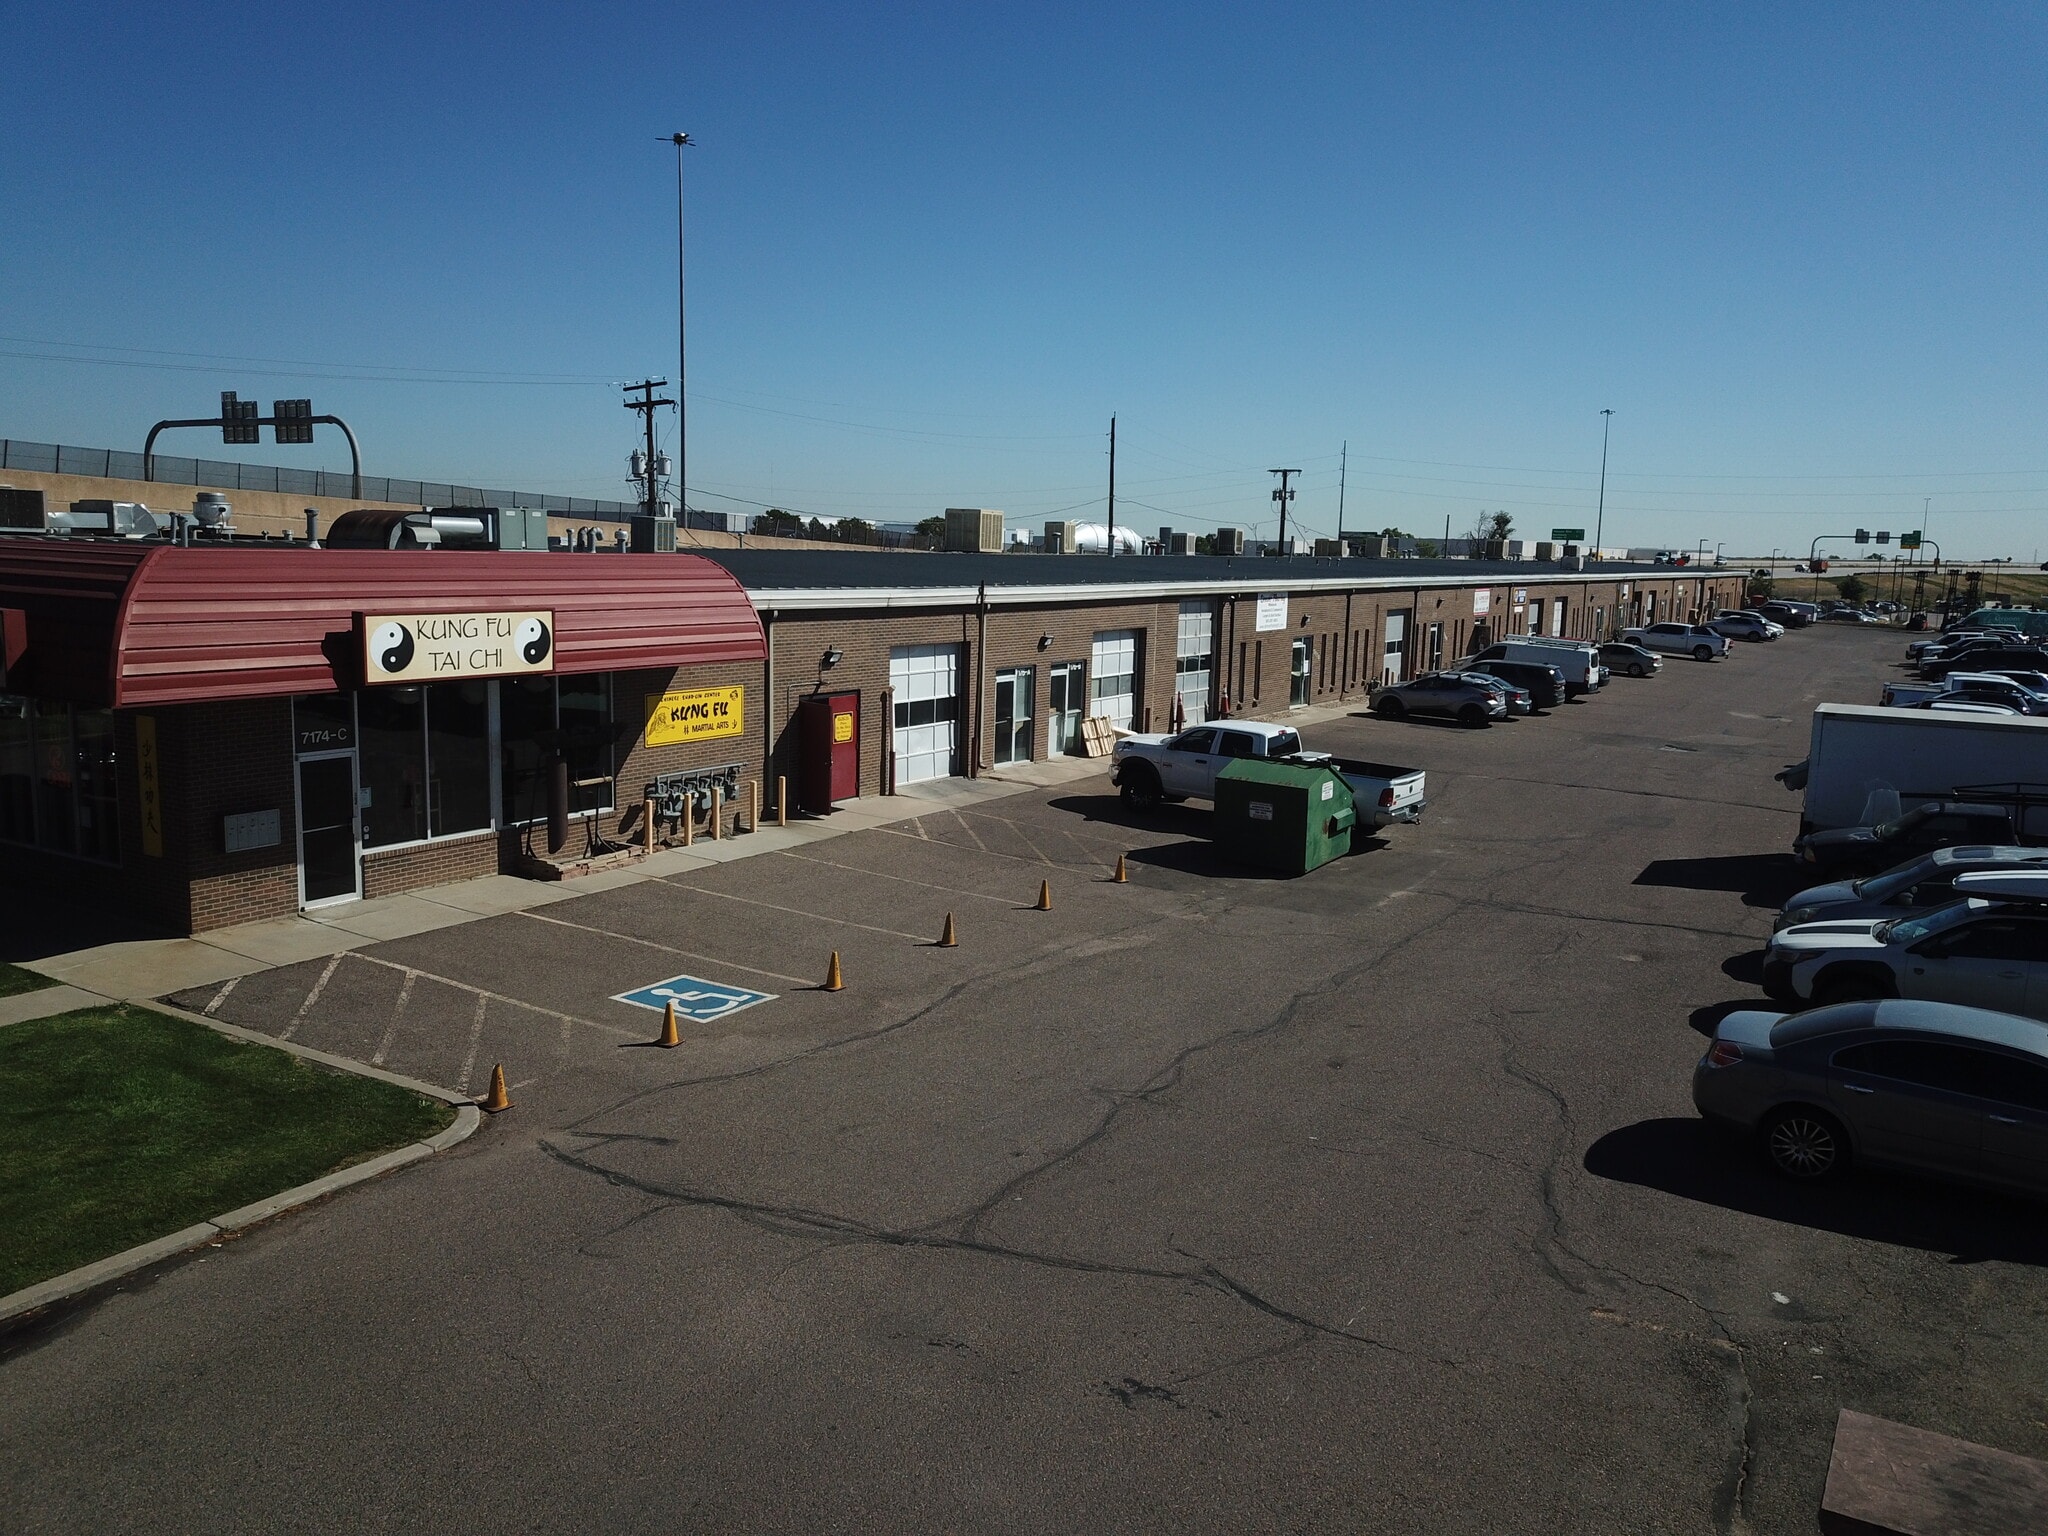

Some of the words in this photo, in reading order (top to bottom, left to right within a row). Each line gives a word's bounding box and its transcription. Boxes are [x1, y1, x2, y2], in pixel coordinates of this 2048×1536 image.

[417, 618, 478, 640] KUNG
[486, 617, 511, 637] FU
[428, 651, 460, 672] TAI
[469, 648, 502, 669] CHI
[671, 703, 709, 722] KUNG
[713, 702, 729, 717] FU
[301, 728, 348, 744] 7174-C
[692, 722, 715, 733] MARTIAL
[716, 720, 729, 730] ARTS
